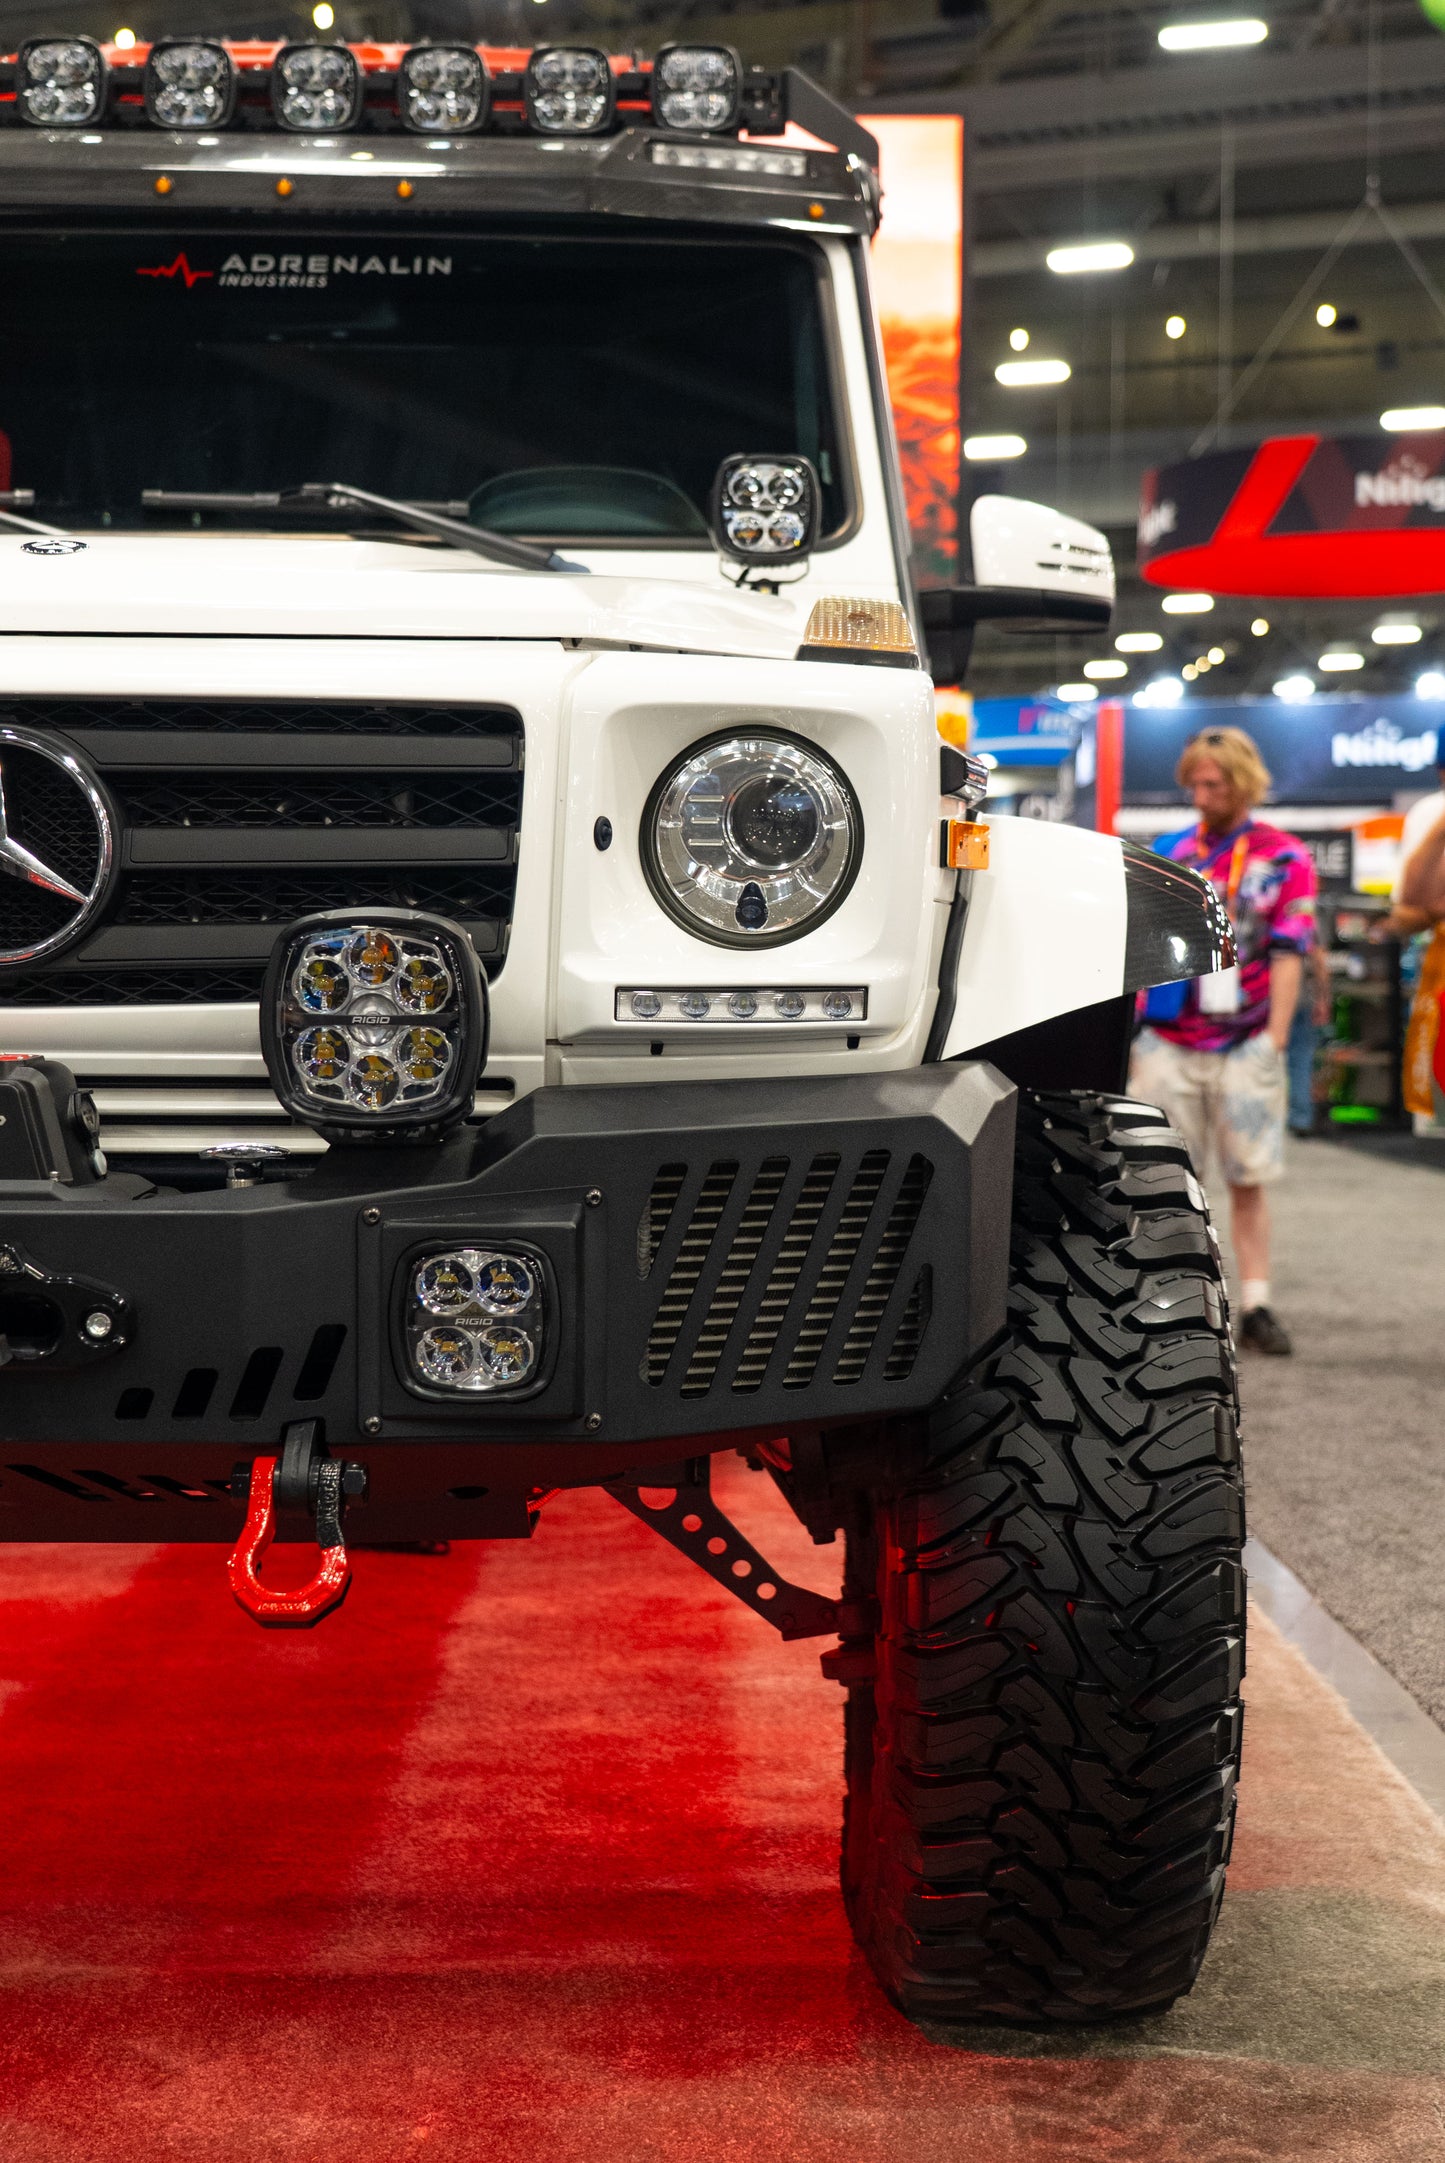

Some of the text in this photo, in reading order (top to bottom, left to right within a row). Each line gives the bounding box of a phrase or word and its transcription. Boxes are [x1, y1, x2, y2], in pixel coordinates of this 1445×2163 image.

[221, 253, 451, 275] ADRENALIN
[219, 274, 328, 288] INDUSTRIES
[352, 1016, 391, 1024] RIGID
[455, 1317, 494, 1326] RIGID
